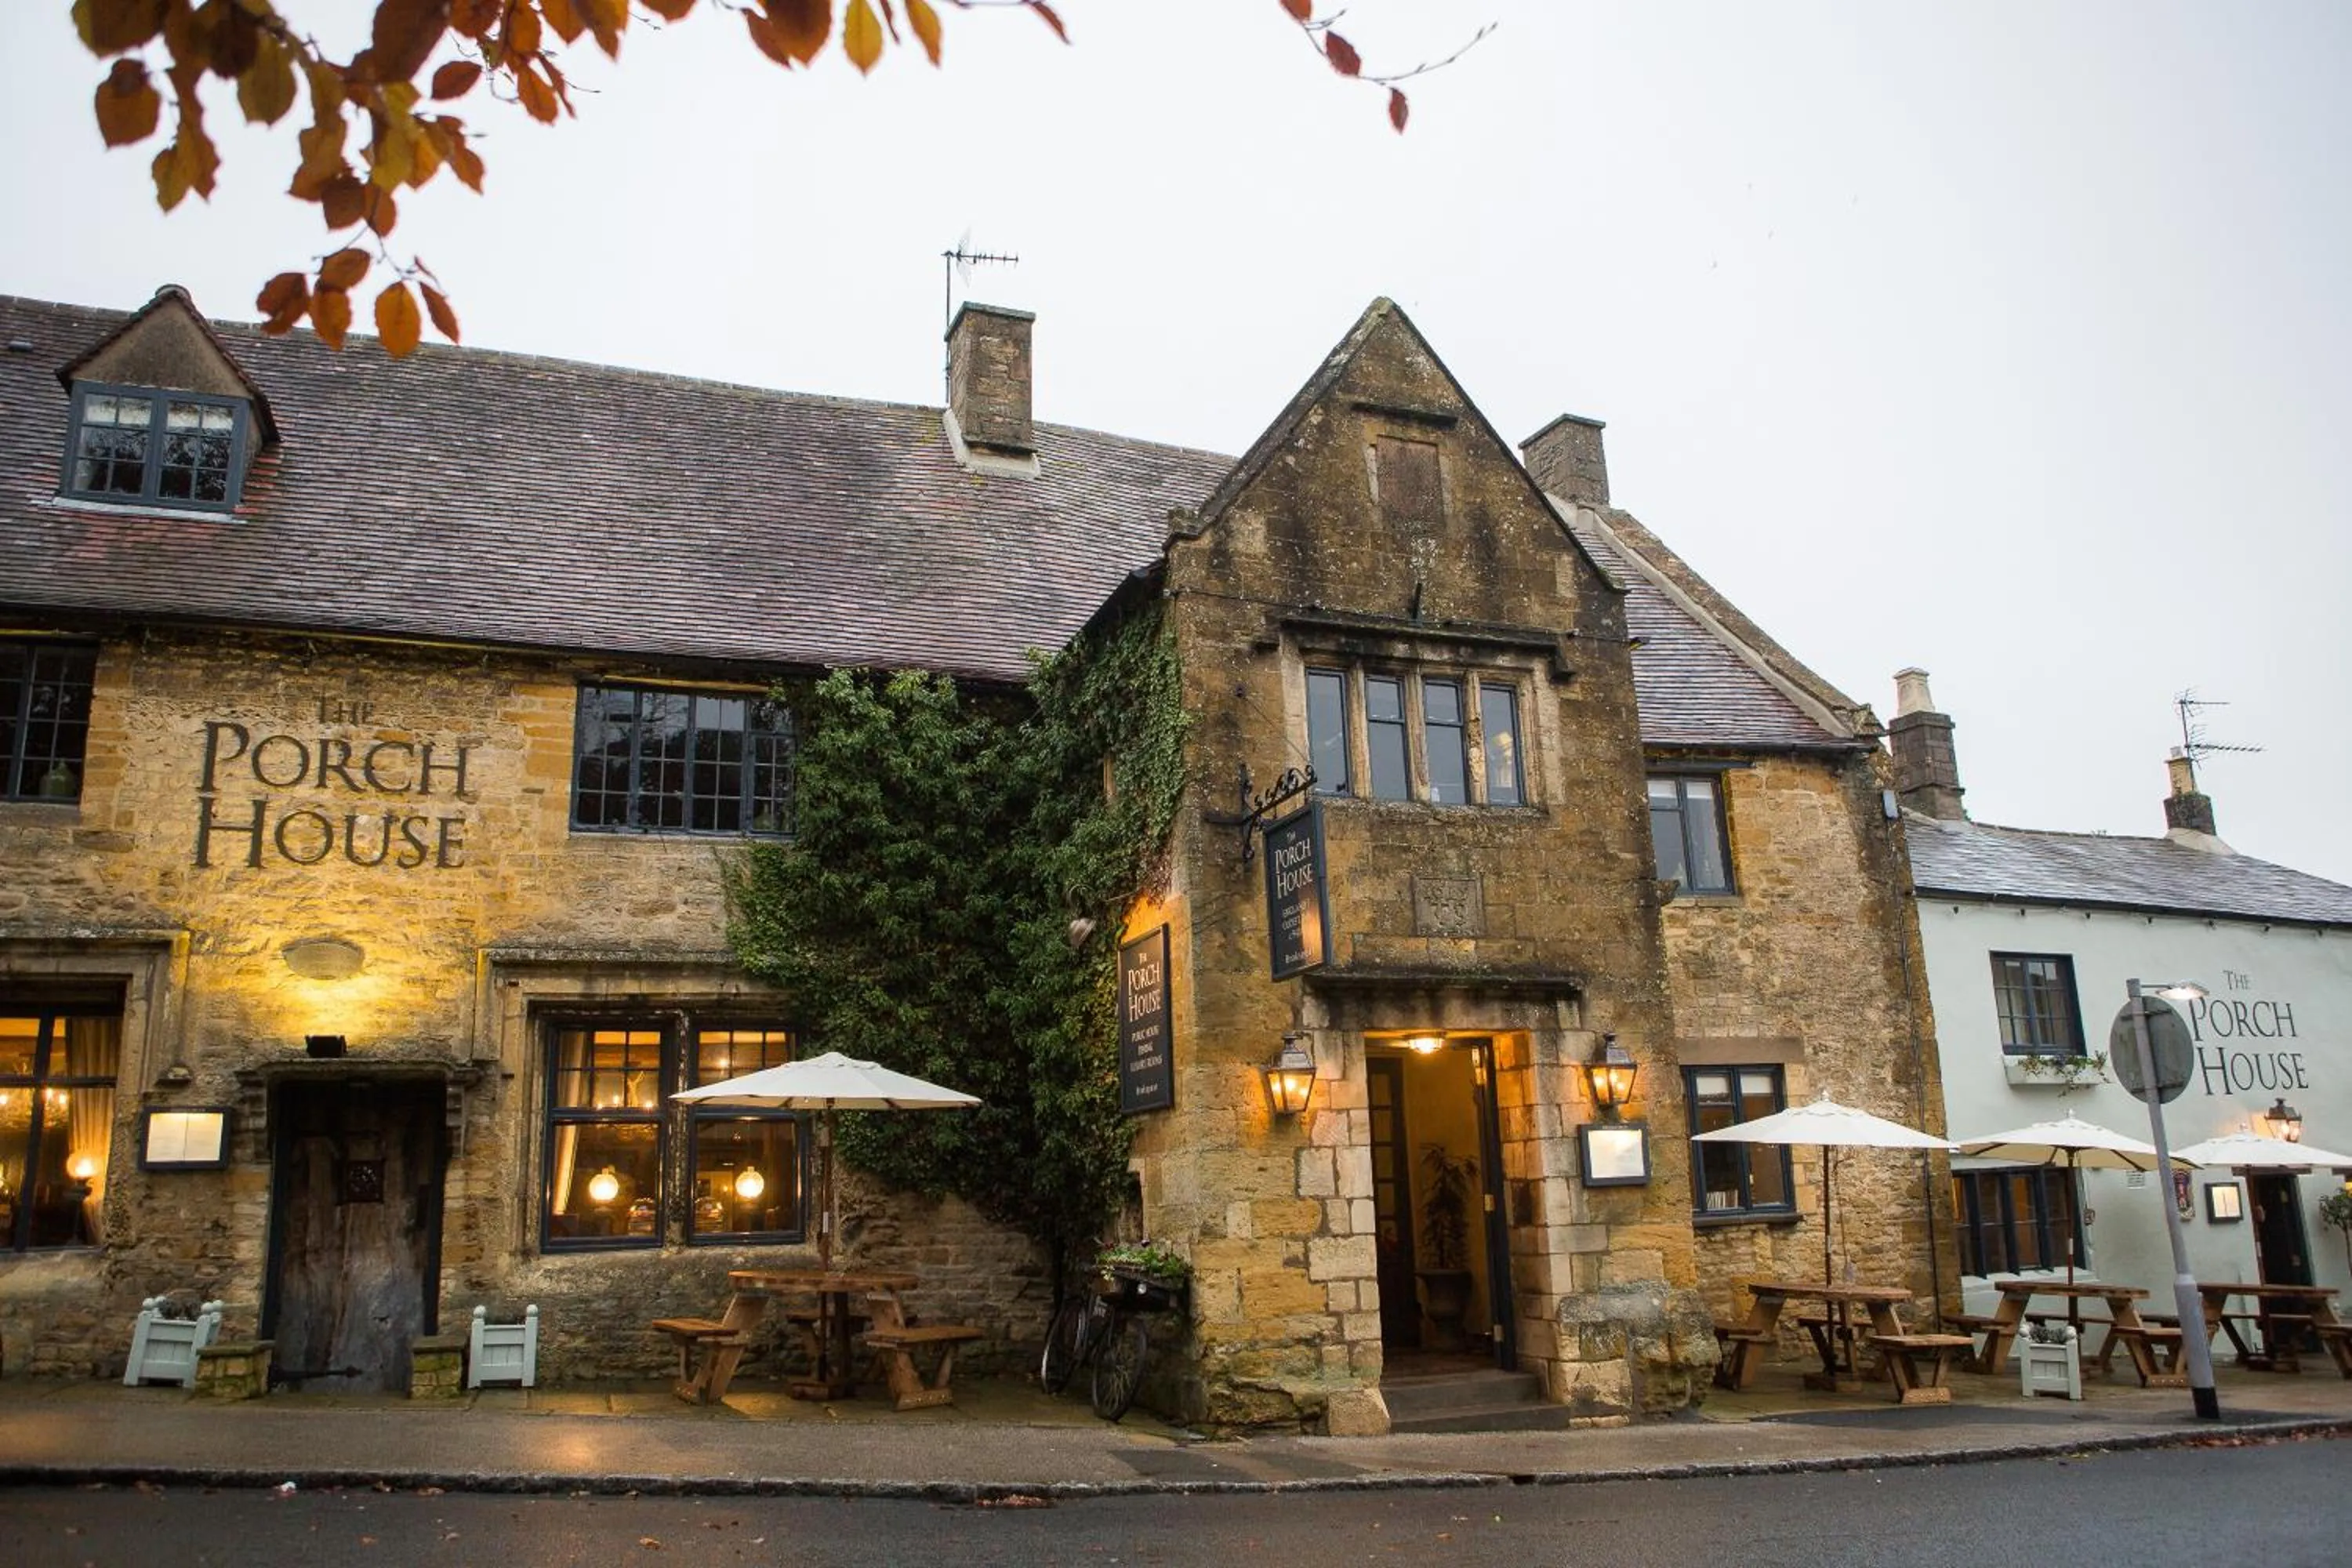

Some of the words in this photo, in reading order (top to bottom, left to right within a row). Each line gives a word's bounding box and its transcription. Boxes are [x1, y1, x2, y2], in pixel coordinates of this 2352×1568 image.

[195, 720, 470, 796] PORCH
[191, 796, 466, 869] HOUSE
[1275, 837, 1312, 873] PORCH
[1276, 864, 1313, 899] HOUSE
[1128, 961, 1160, 996] PORCH
[2223, 970, 2250, 991] THE
[1129, 989, 1161, 1022] HOUSE
[2188, 996, 2298, 1042] PORCH
[2196, 1047, 2310, 1096] HOUSE
